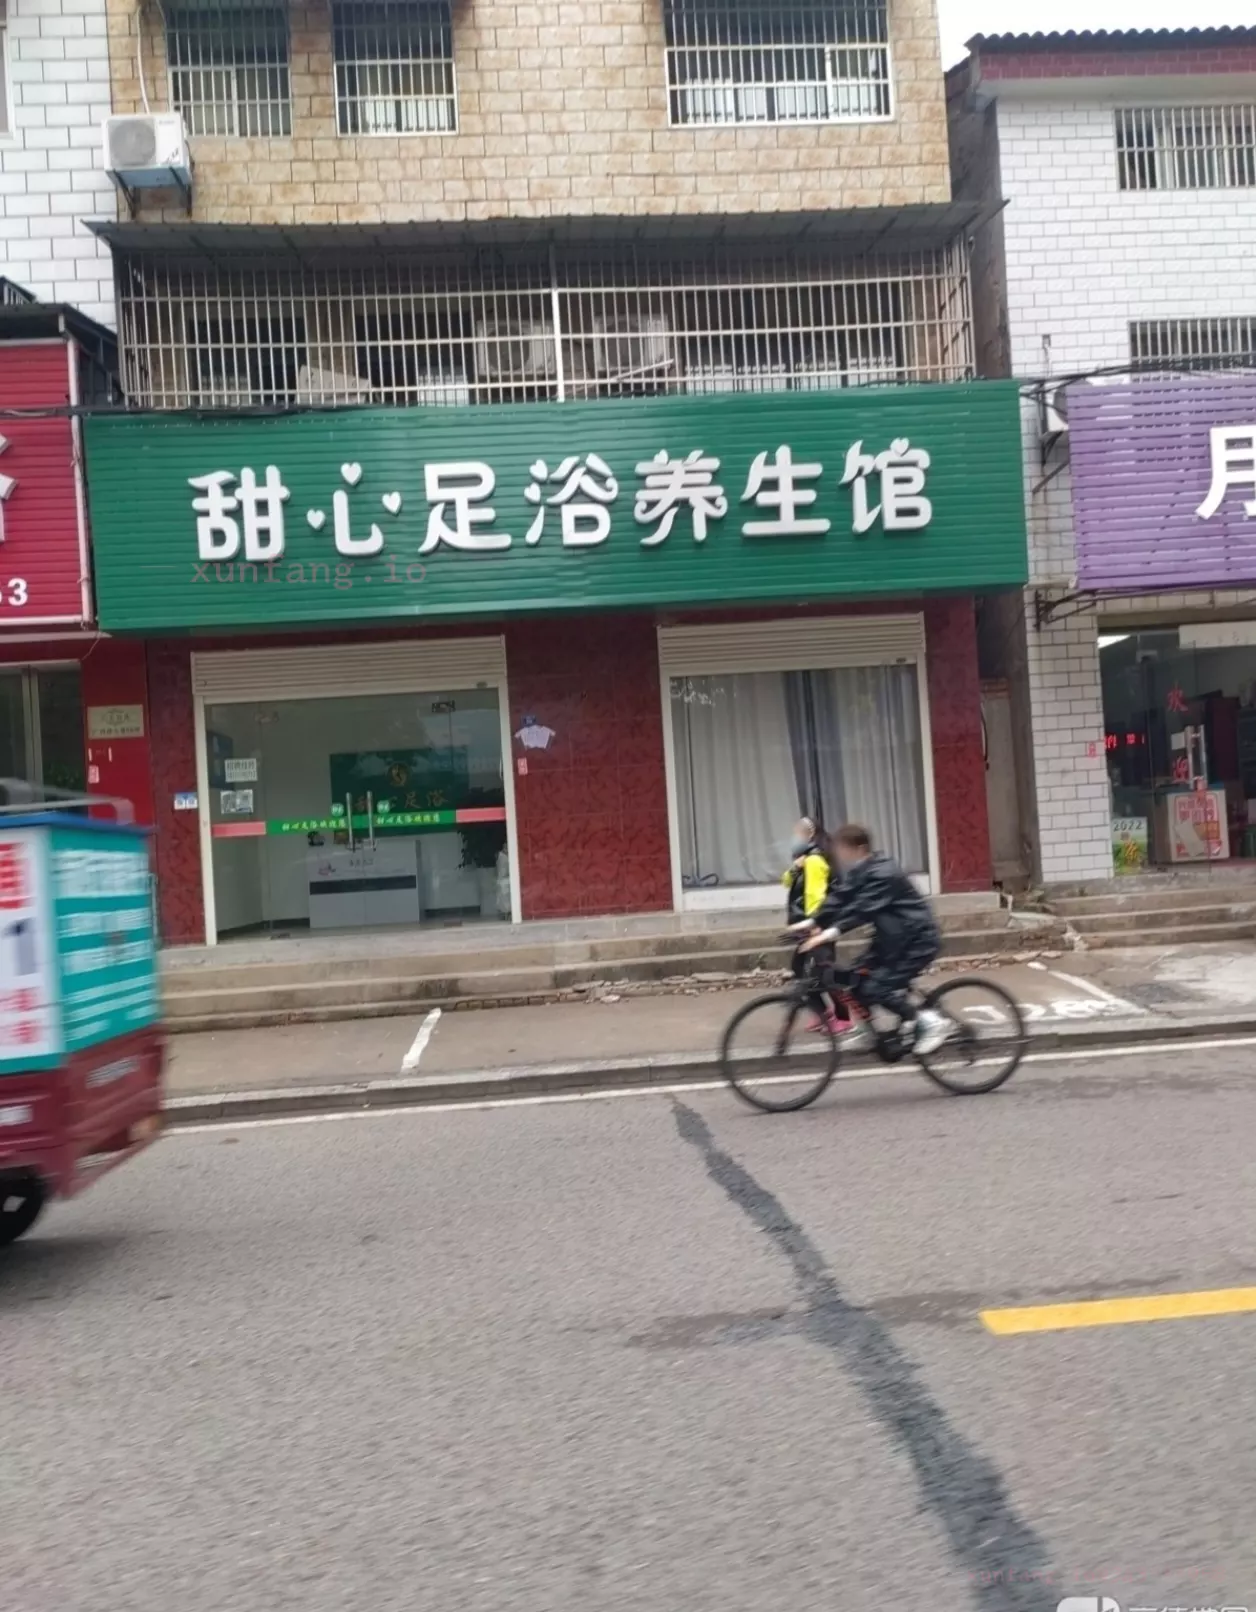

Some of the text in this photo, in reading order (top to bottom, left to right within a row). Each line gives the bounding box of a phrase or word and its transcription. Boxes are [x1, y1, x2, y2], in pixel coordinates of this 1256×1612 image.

[188, 439, 932, 559] 甜心足浴养生馆
[1113, 819, 1144, 832] 2022
